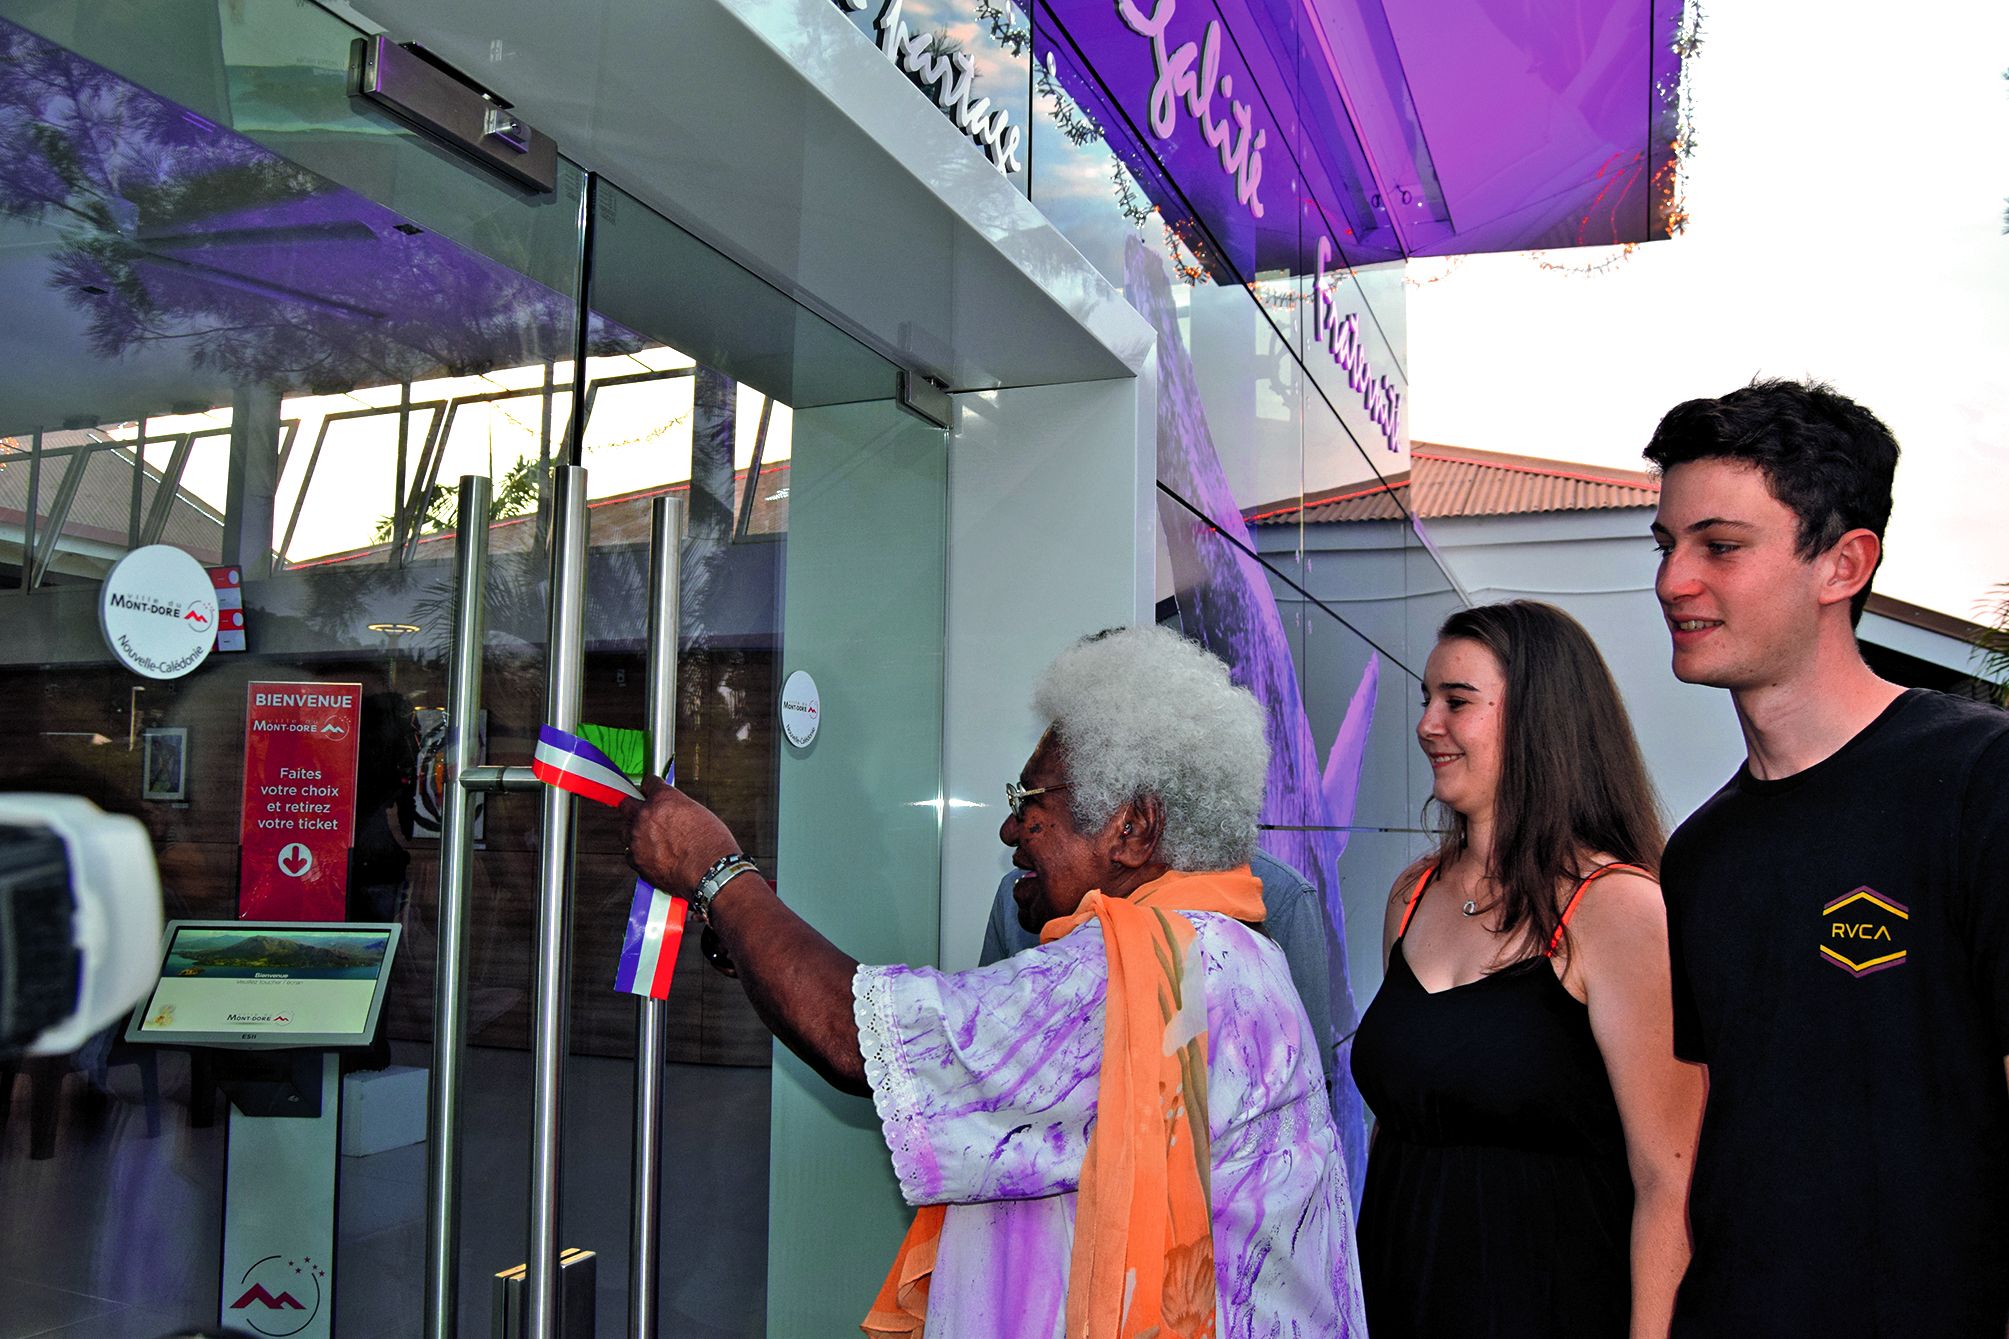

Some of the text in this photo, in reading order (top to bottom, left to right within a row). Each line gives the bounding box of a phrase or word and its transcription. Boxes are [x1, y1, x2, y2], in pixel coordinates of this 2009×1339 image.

[1116, 0, 1266, 218] galité
[118, 634, 205, 673] Nouvelle-Calédonie
[255, 693, 353, 708] BIENVENUE
[279, 767, 322, 780] Faites
[260, 784, 340, 797] votre choix
[266, 801, 331, 813] et retirez
[257, 817, 338, 830] votre ticket
[1831, 922, 1892, 941] RVCA
